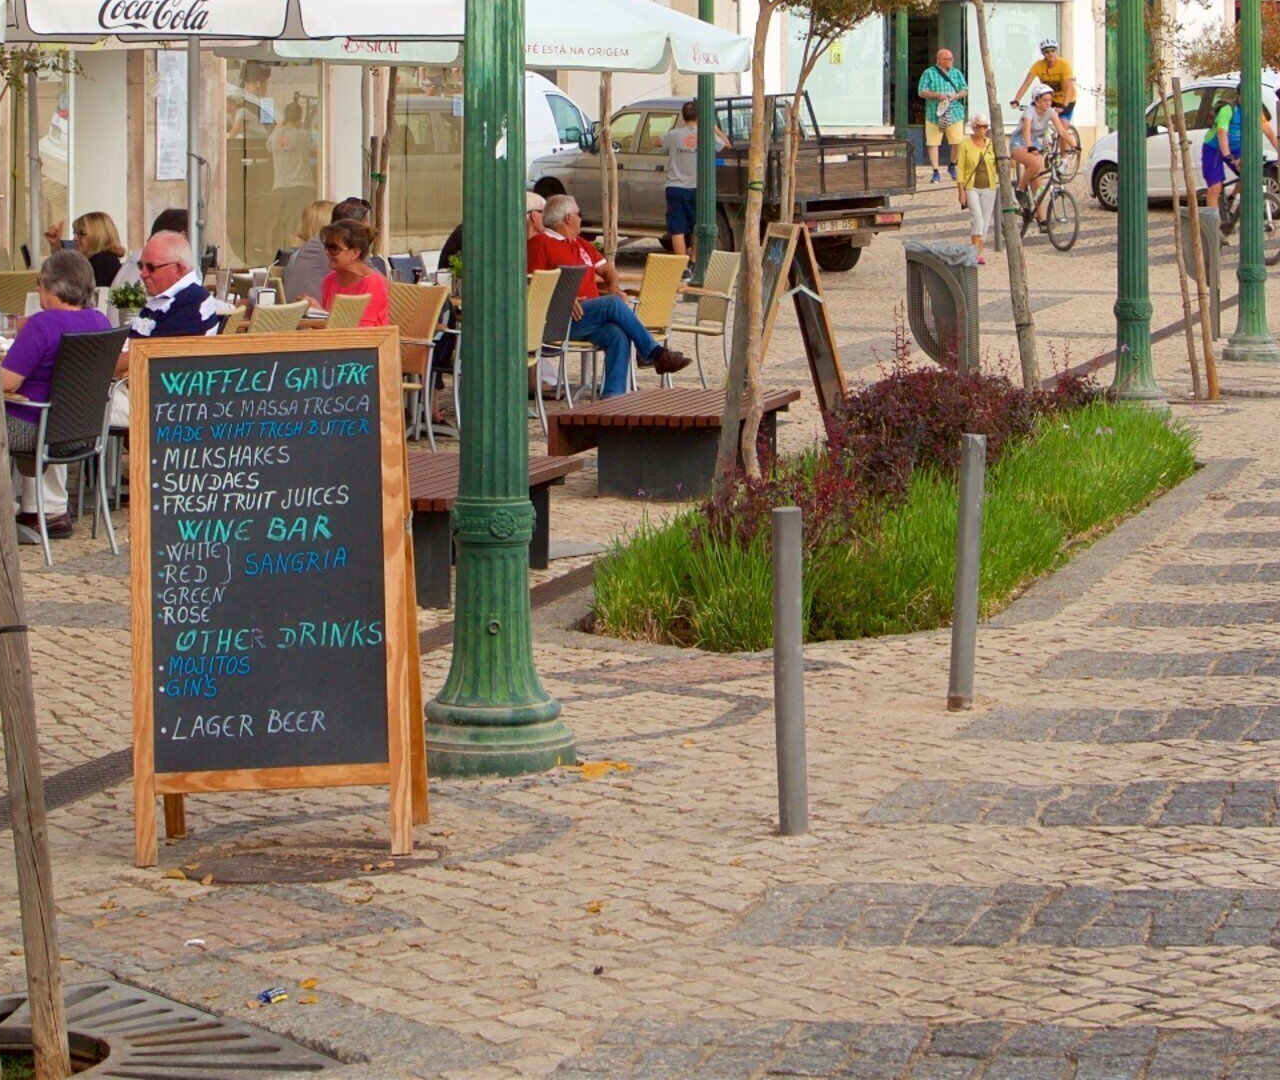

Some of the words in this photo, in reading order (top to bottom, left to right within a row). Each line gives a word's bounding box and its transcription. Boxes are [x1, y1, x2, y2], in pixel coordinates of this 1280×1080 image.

[542, 43, 566, 54] ESTÁ
[570, 46, 585, 55] NA
[587, 46, 629, 57] ORIGEM
[155, 403, 208, 422] FEITA
[240, 399, 298, 417] MASSA
[303, 395, 370, 415] FRESCA
[156, 425, 204, 444] MADE
[259, 421, 304, 438] FRESH
[307, 417, 370, 436] BUTTER
[163, 445, 291, 470] MILKSHAKES
[162, 471, 260, 493] SUNDAES
[162, 492, 218, 516] FRESH
[223, 490, 277, 513] FRUIT
[281, 485, 350, 509] JUICES
[177, 518, 254, 544] WINE
[266, 515, 333, 542] BAR
[244, 546, 348, 576] SANGRIA
[176, 628, 267, 653] OTHER
[277, 620, 384, 650] DRINKS
[168, 655, 252, 677] MOJITOS
[171, 715, 255, 740] LAGER
[267, 709, 327, 734] BEER
